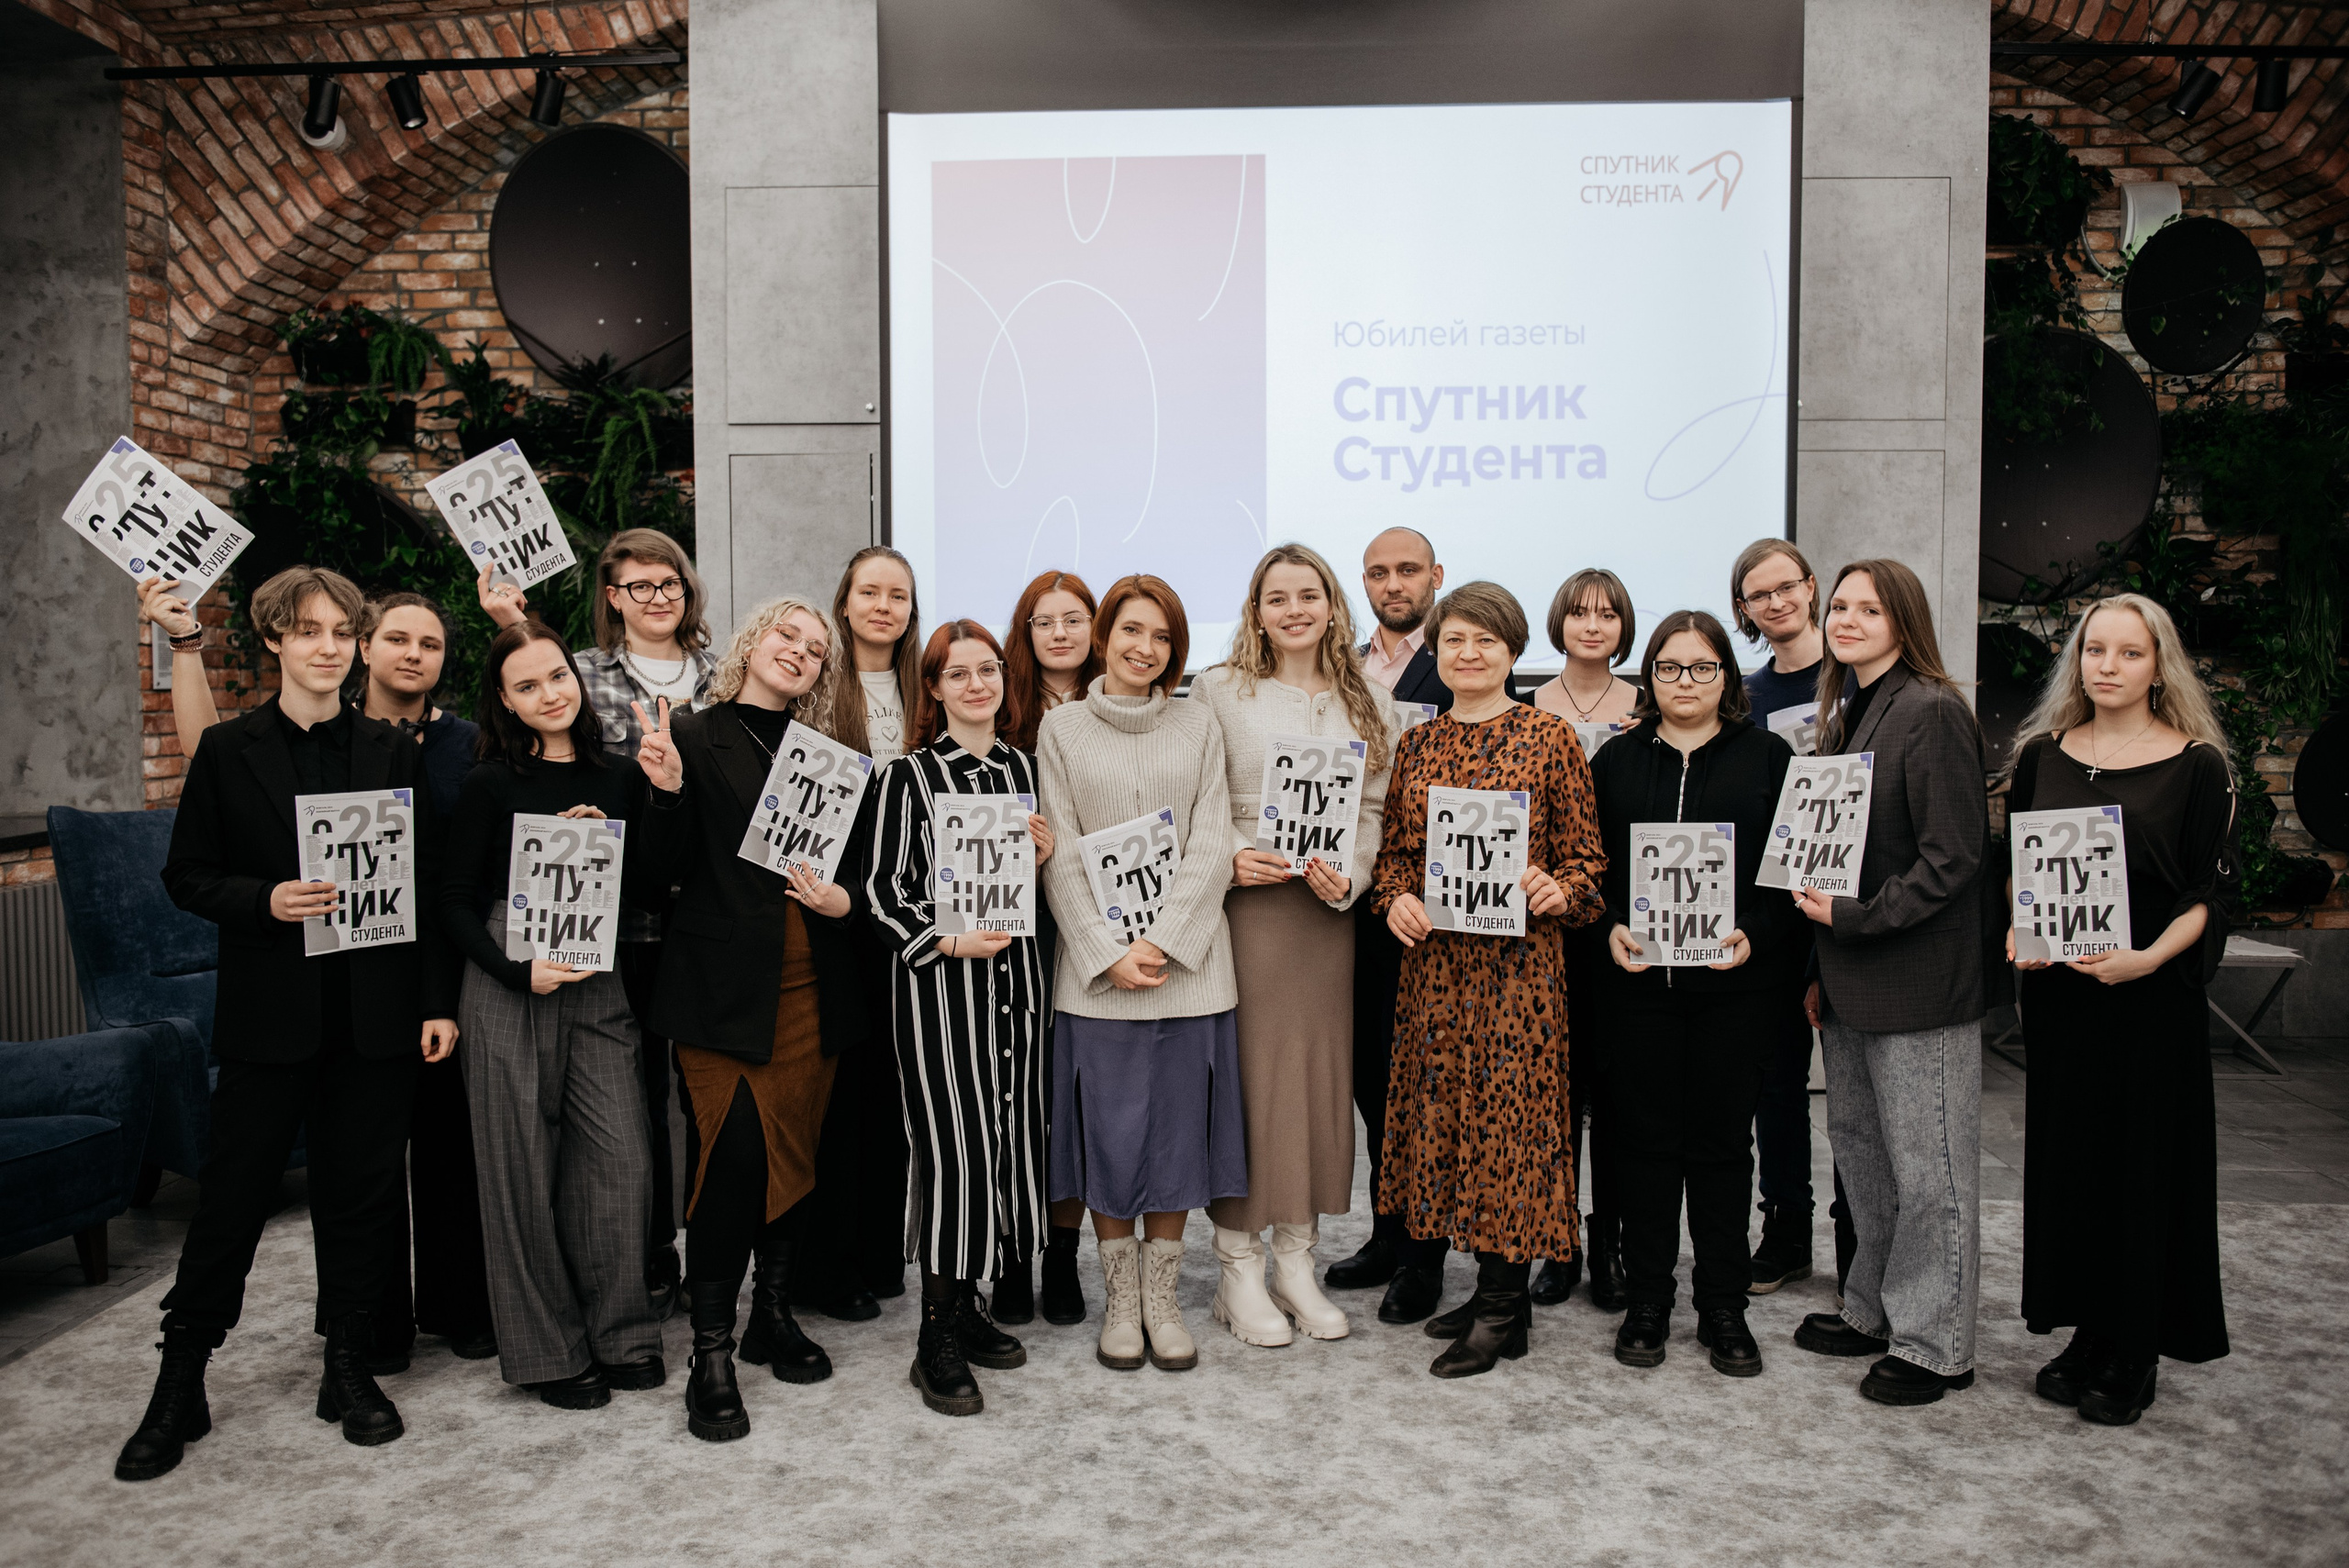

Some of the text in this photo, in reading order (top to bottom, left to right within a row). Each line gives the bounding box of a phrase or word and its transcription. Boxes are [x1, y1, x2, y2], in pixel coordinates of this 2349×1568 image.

[1580, 154, 1680, 174] СПУТНИК
[1580, 183, 1685, 207] СТУДЕНТА
[1334, 319, 1586, 348] Юбилей газеты
[1333, 376, 1587, 434] Спутник
[1333, 436, 1608, 494] Студента
[95, 451, 157, 518] 25
[466, 450, 528, 505] 25
[157, 514, 187, 546] лет
[506, 524, 527, 540] лет
[200, 533, 242, 577] СТУДЕНТА
[526, 553, 566, 581] СТУДЕНТА
[874, 706, 902, 721] LIKE
[807, 750, 859, 799] 25
[1299, 748, 1357, 789] 25
[1816, 762, 1866, 806] 25
[340, 798, 406, 850] 25
[793, 814, 818, 828] лет
[969, 802, 1029, 846] 25
[1299, 815, 1325, 825] лет
[1460, 800, 1520, 843] 25
[1121, 821, 1174, 872] 25
[1810, 833, 1834, 842] лет
[2049, 815, 2117, 864] 25
[550, 828, 615, 873] 25
[1665, 831, 1727, 874] 25
[350, 879, 377, 892] лет
[975, 874, 1001, 884] лет
[1465, 872, 1490, 881] лет
[1800, 876, 1847, 890] СТУДЕНТА
[551, 903, 580, 913] лет
[1143, 895, 1164, 911] лет
[1673, 903, 1698, 913] лет
[2059, 895, 2087, 905] лет
[351, 925, 405, 942] СТУДЕНТА
[976, 920, 1025, 931] СТУДЕНТА
[1465, 916, 1515, 929] СТУДЕНТА
[549, 951, 601, 965] СТУДЕНТА
[1674, 949, 1723, 962] СТУДЕНТА
